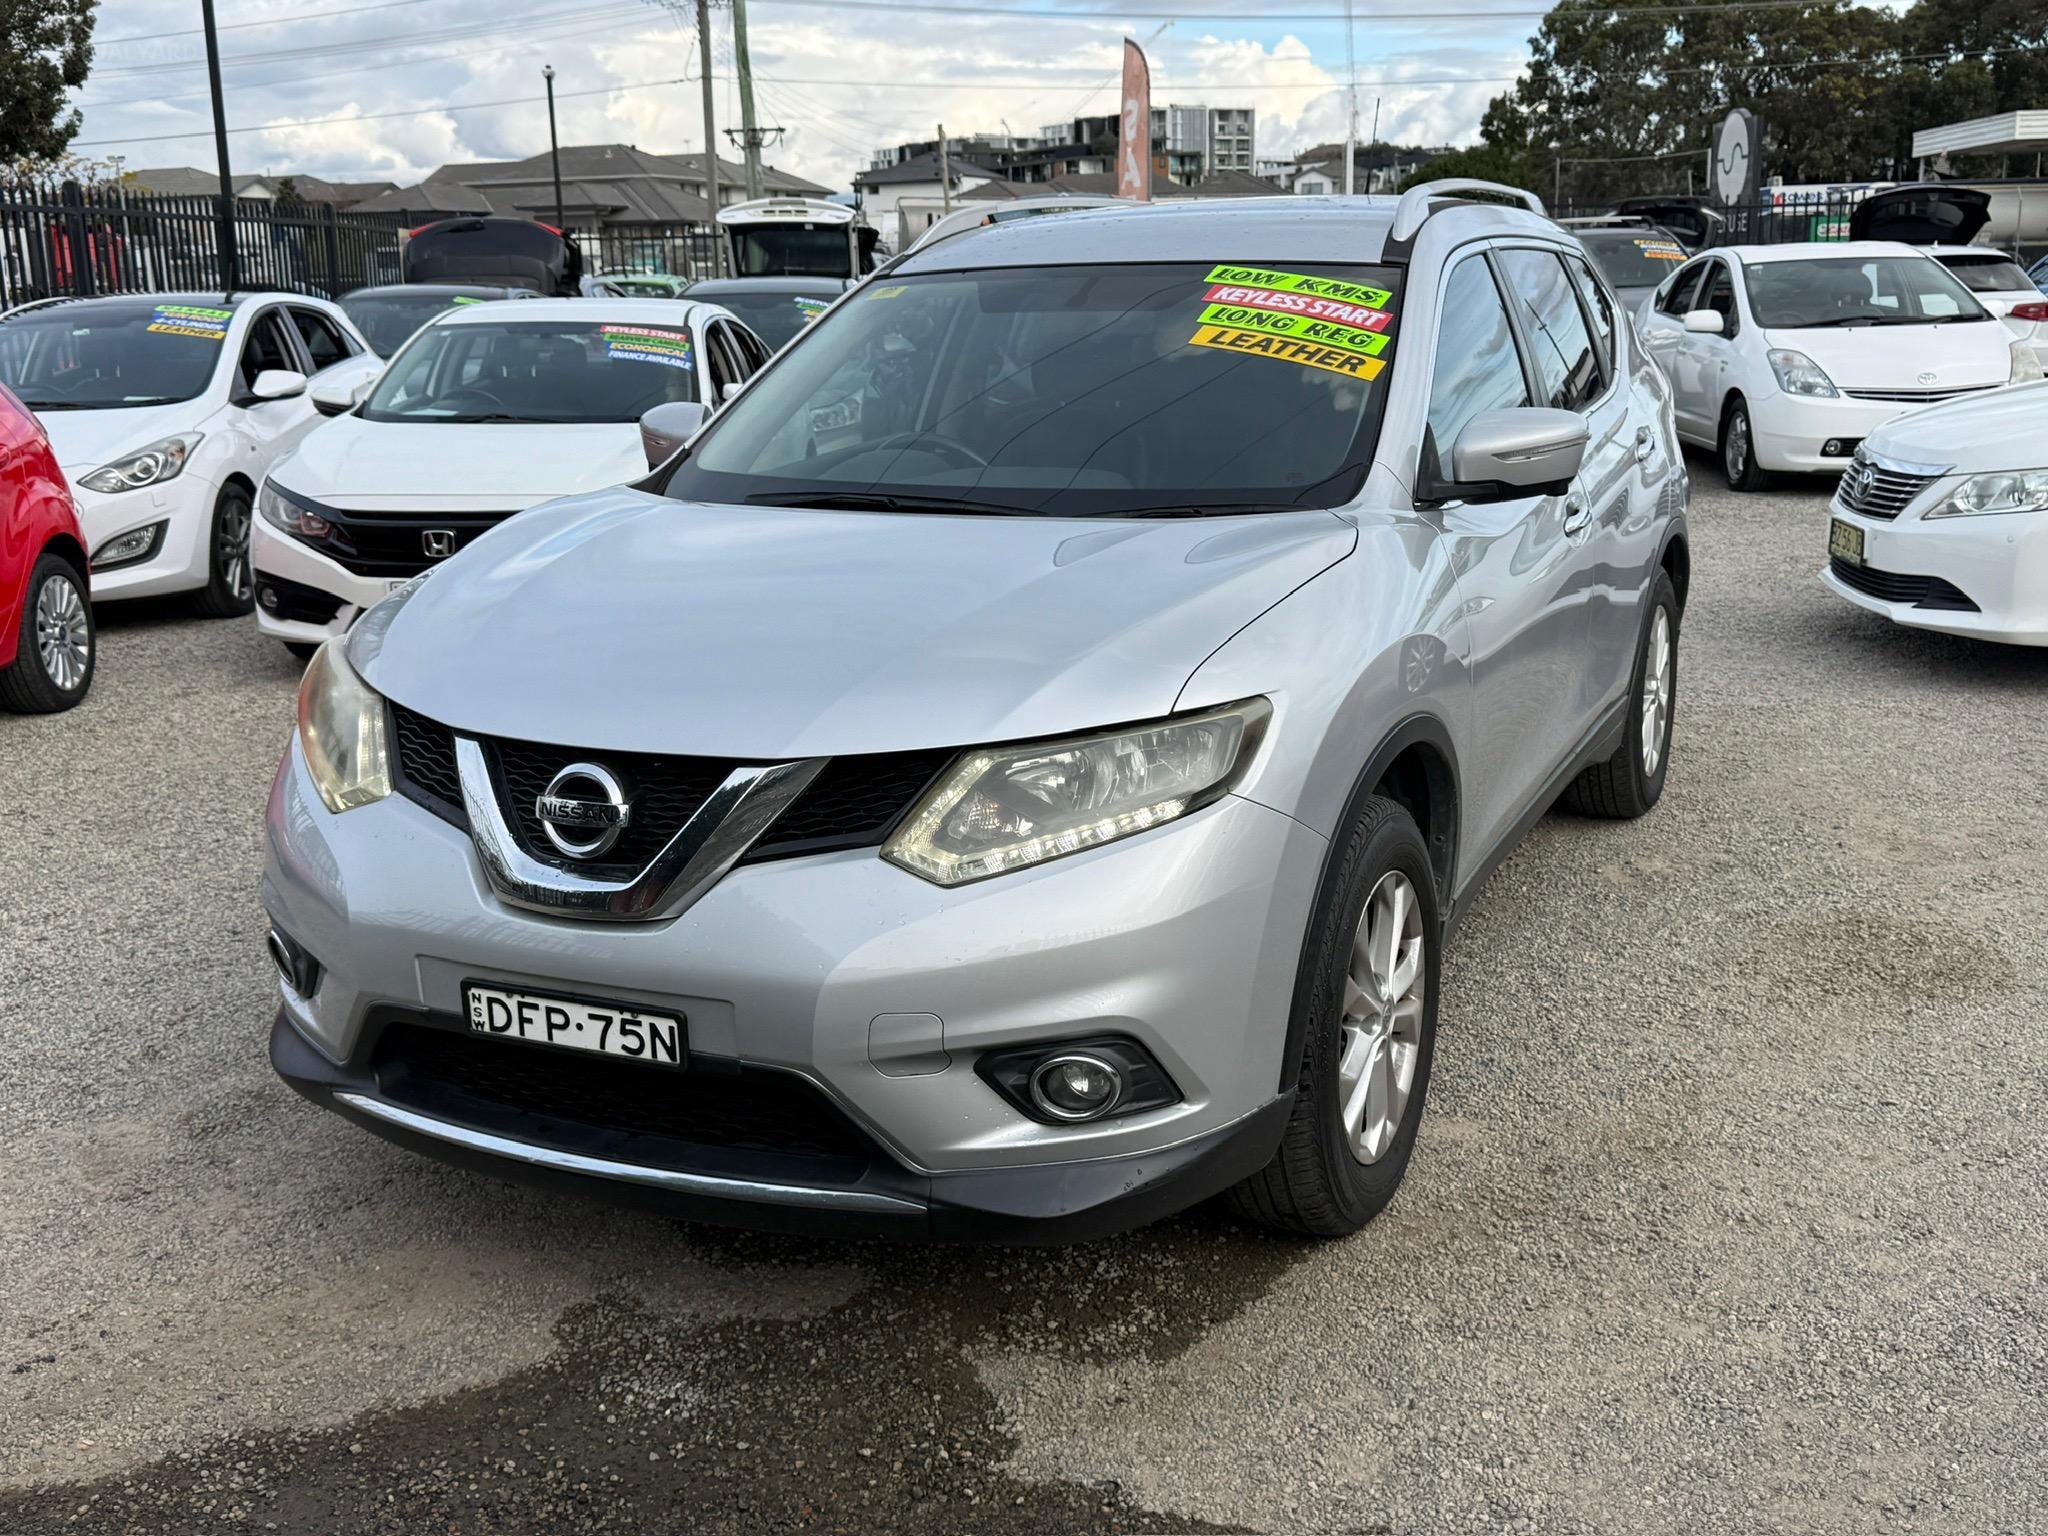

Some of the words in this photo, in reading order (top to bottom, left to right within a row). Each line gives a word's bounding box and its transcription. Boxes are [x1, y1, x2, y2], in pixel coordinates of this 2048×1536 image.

[1213, 268, 1288, 286] LOW
[1293, 278, 1382, 303] KMS
[1214, 286, 1307, 311] KEYLESS
[1308, 300, 1386, 326] START
[155, 325, 218, 337] LEATHER
[604, 325, 649, 336] KEYLESS
[649, 329, 683, 341] START
[1210, 306, 1298, 330] LONG
[1303, 322, 1375, 347] REG
[608, 350, 646, 361] FINANCE
[646, 354, 692, 370] AVAILABLE
[609, 342, 687, 359] ECONOMICAL
[1207, 330, 1367, 373] LEATHER
[541, 801, 614, 823] NISSAN
